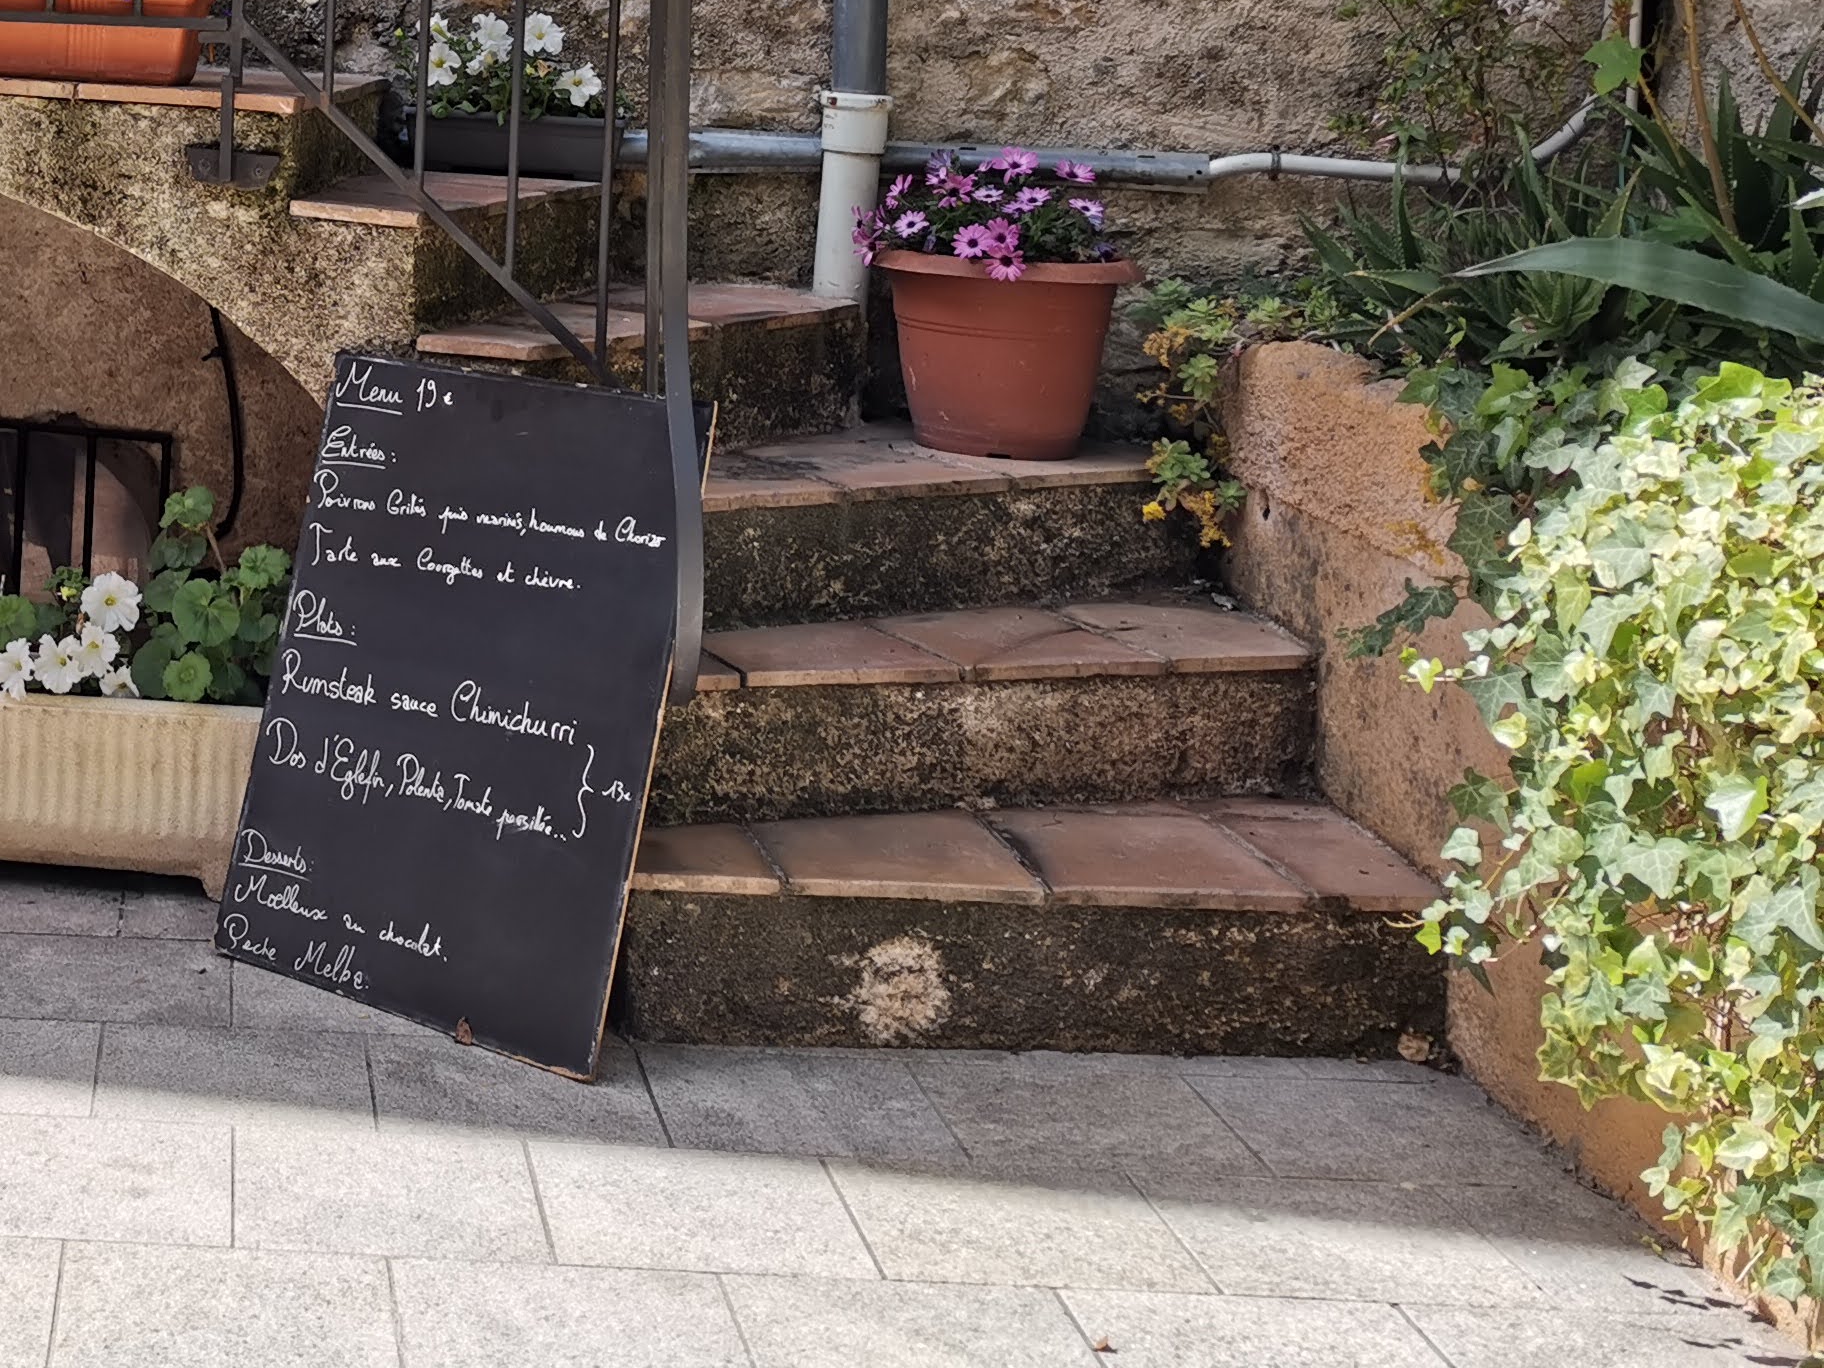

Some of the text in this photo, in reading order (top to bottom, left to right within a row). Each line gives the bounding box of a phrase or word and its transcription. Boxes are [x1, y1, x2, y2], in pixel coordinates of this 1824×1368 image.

[335, 362, 403, 403] Menu
[313, 469, 376, 511] Poivrons
[438, 506, 469, 535] puis
[594, 520, 608, 541] de
[614, 516, 667, 548] Chorizo
[309, 522, 359, 566] Tarte
[371, 552, 402, 567] aux
[417, 547, 484, 585] Courgettes
[496, 561, 516, 583] et
[281, 648, 578, 745] Rumsteak sauce Chimichurri
[266, 717, 307, 769] Dos
[342, 913, 366, 934] au
